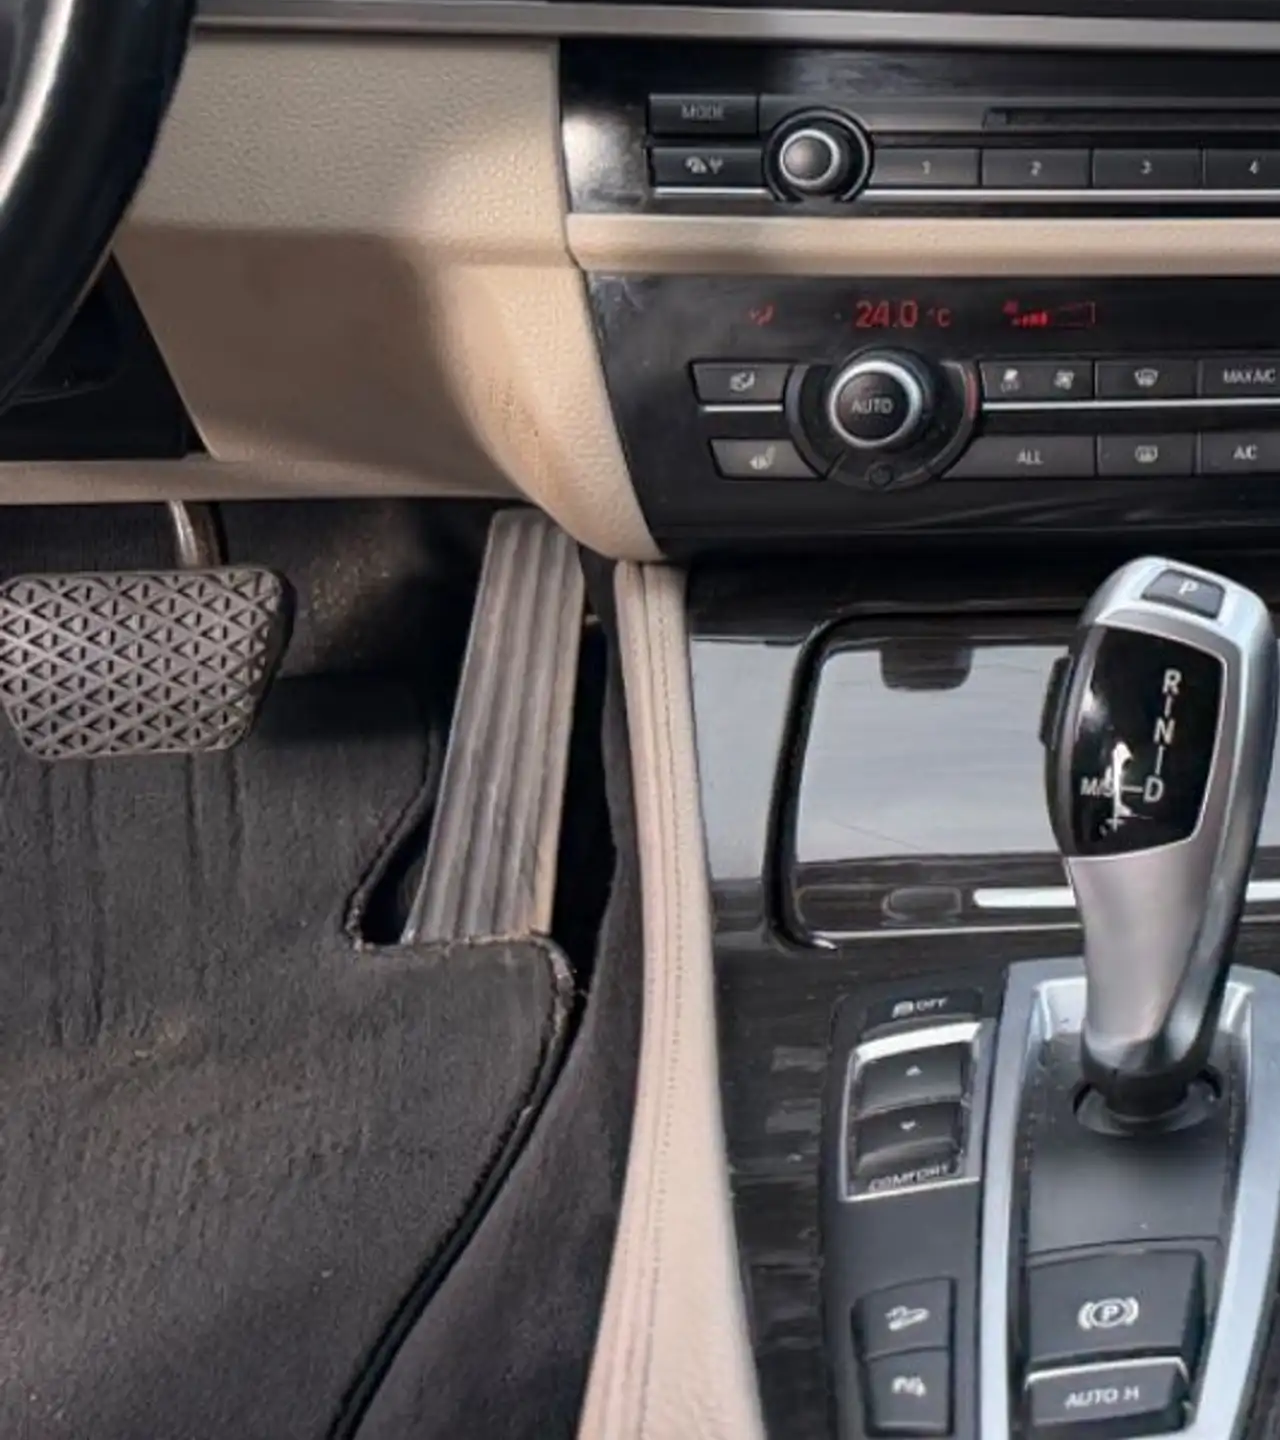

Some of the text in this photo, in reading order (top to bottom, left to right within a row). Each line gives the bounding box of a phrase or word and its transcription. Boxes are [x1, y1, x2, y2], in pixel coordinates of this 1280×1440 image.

[681, 103, 725, 120] MODE
[922, 159, 931, 175] 1
[1030, 160, 1042, 176] 2
[1140, 159, 1152, 175] 3
[1249, 159, 1260, 175] 4
[855, 300, 919, 329] 24.0
[850, 398, 895, 416] AUTO
[1017, 449, 1043, 466] ALL
[1178, 579, 1199, 595] P
[1162, 668, 1182, 695] R
[1153, 717, 1176, 744] N
[1143, 774, 1165, 803] D
[916, 997, 947, 1011] OFF
[867, 1163, 951, 1192] COMFORT
[1102, 1305, 1119, 1322] P
[1064, 1385, 1140, 1409] AUTO H
